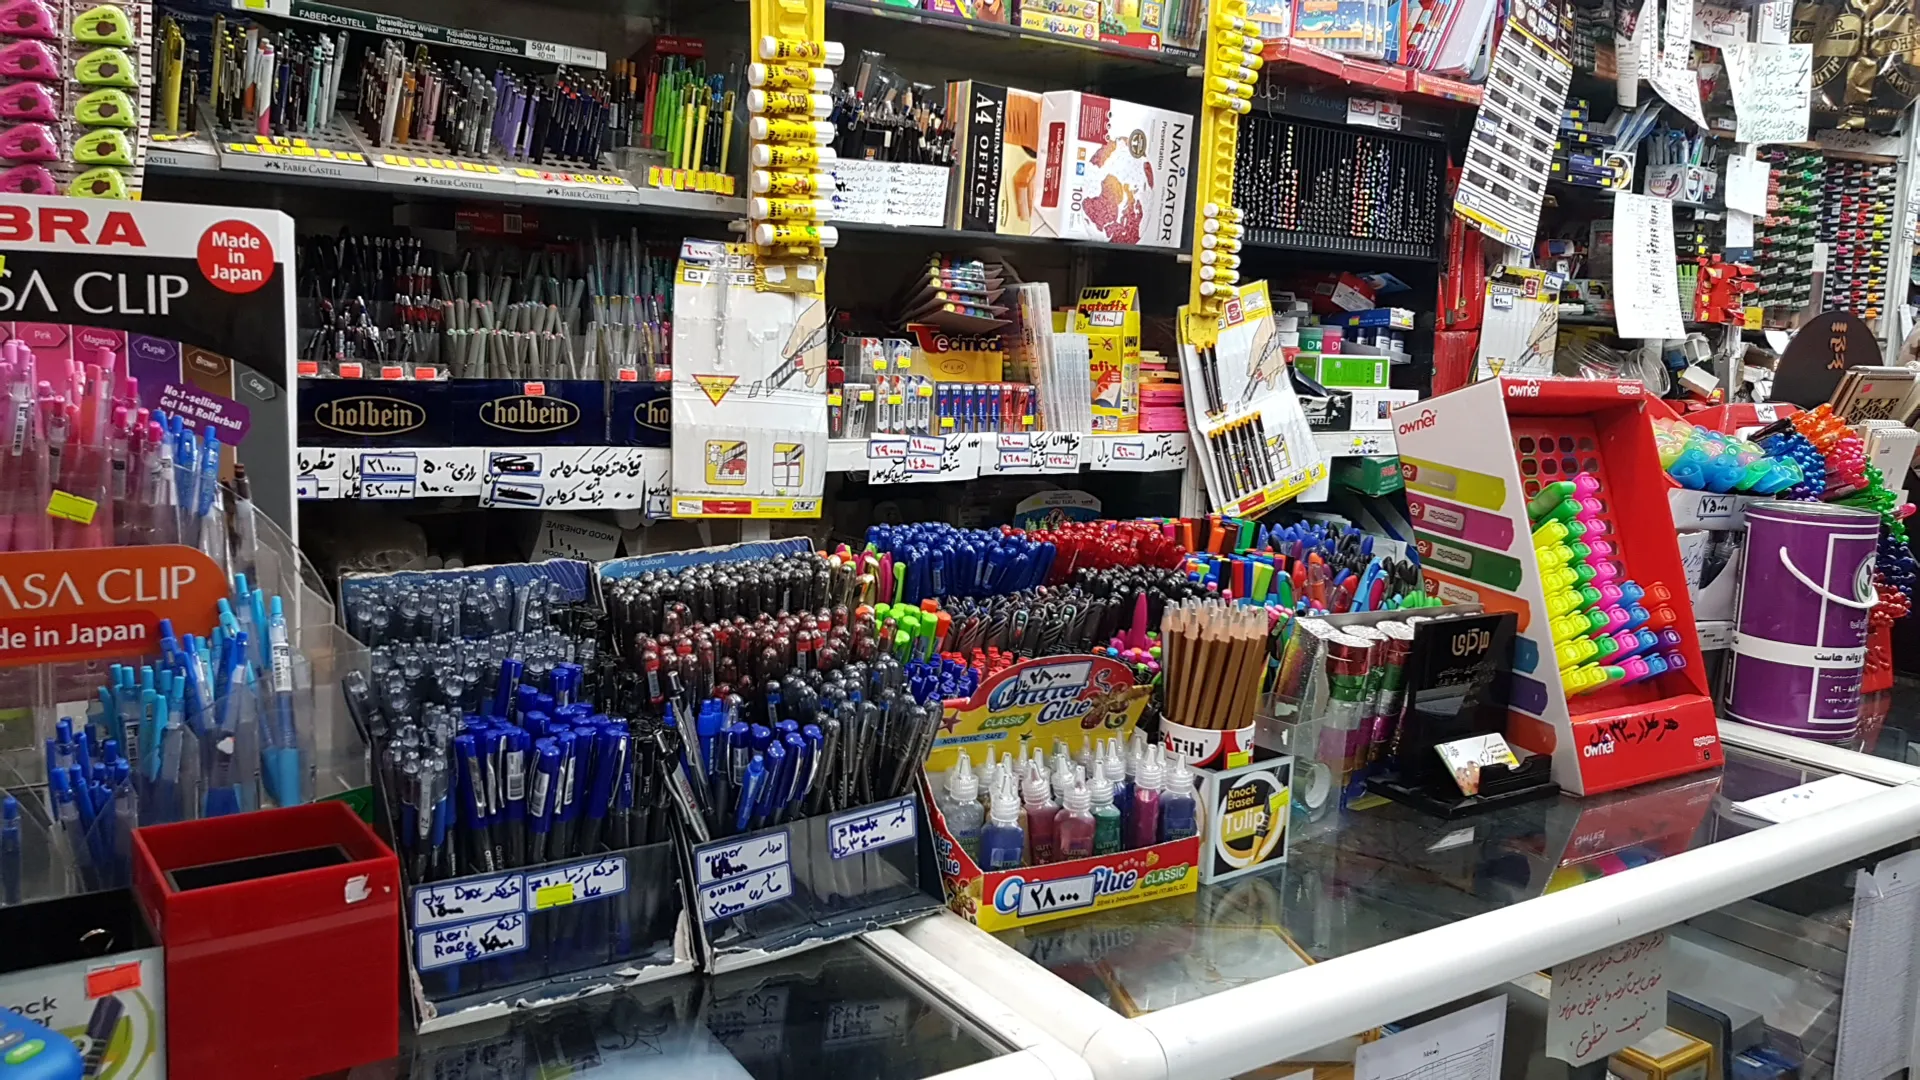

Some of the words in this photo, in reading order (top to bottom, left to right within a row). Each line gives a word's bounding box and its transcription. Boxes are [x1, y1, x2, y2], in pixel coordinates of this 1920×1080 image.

[300, 10, 366, 28] FABER-CASTELL
[531, 42, 556, 53] 59/44
[975, 92, 995, 124] A4
[993, 100, 1004, 150] PREMIUM
[1157, 120, 1168, 171] Presentation
[975, 135, 990, 207] OFFICE
[990, 151, 1001, 188] COPY
[1161, 122, 1185, 242] NAVIGATOR
[987, 188, 997, 224] PAPER
[1070, 186, 1083, 212] 100
[212, 232, 260, 249] Made
[228, 248, 245, 263] in
[211, 264, 262, 283] Japan
[73, 270, 189, 316] CLIP
[1082, 289, 1111, 299] UHU
[1124, 336, 1138, 347] UHU
[1508, 379, 1541, 397] owner
[160, 396, 177, 409] Gel
[178, 402, 194, 414] Ink
[195, 407, 242, 430] Rollerball
[331, 399, 414, 428] holbein
[493, 398, 570, 424] holbein
[1399, 409, 1437, 435] owner
[97, 565, 197, 605] CLIP
[34, 627, 61, 649] in
[66, 623, 147, 646] Japan
[1452, 628, 1490, 656] مرکزی
[984, 712, 1028, 729] CLASSIC
[1037, 699, 1091, 726] Glue
[1227, 796, 1256, 810] Eraser
[1228, 784, 1258, 799] Knock
[1223, 810, 1268, 834] Tulip
[1144, 867, 1186, 884] CLASSIC
